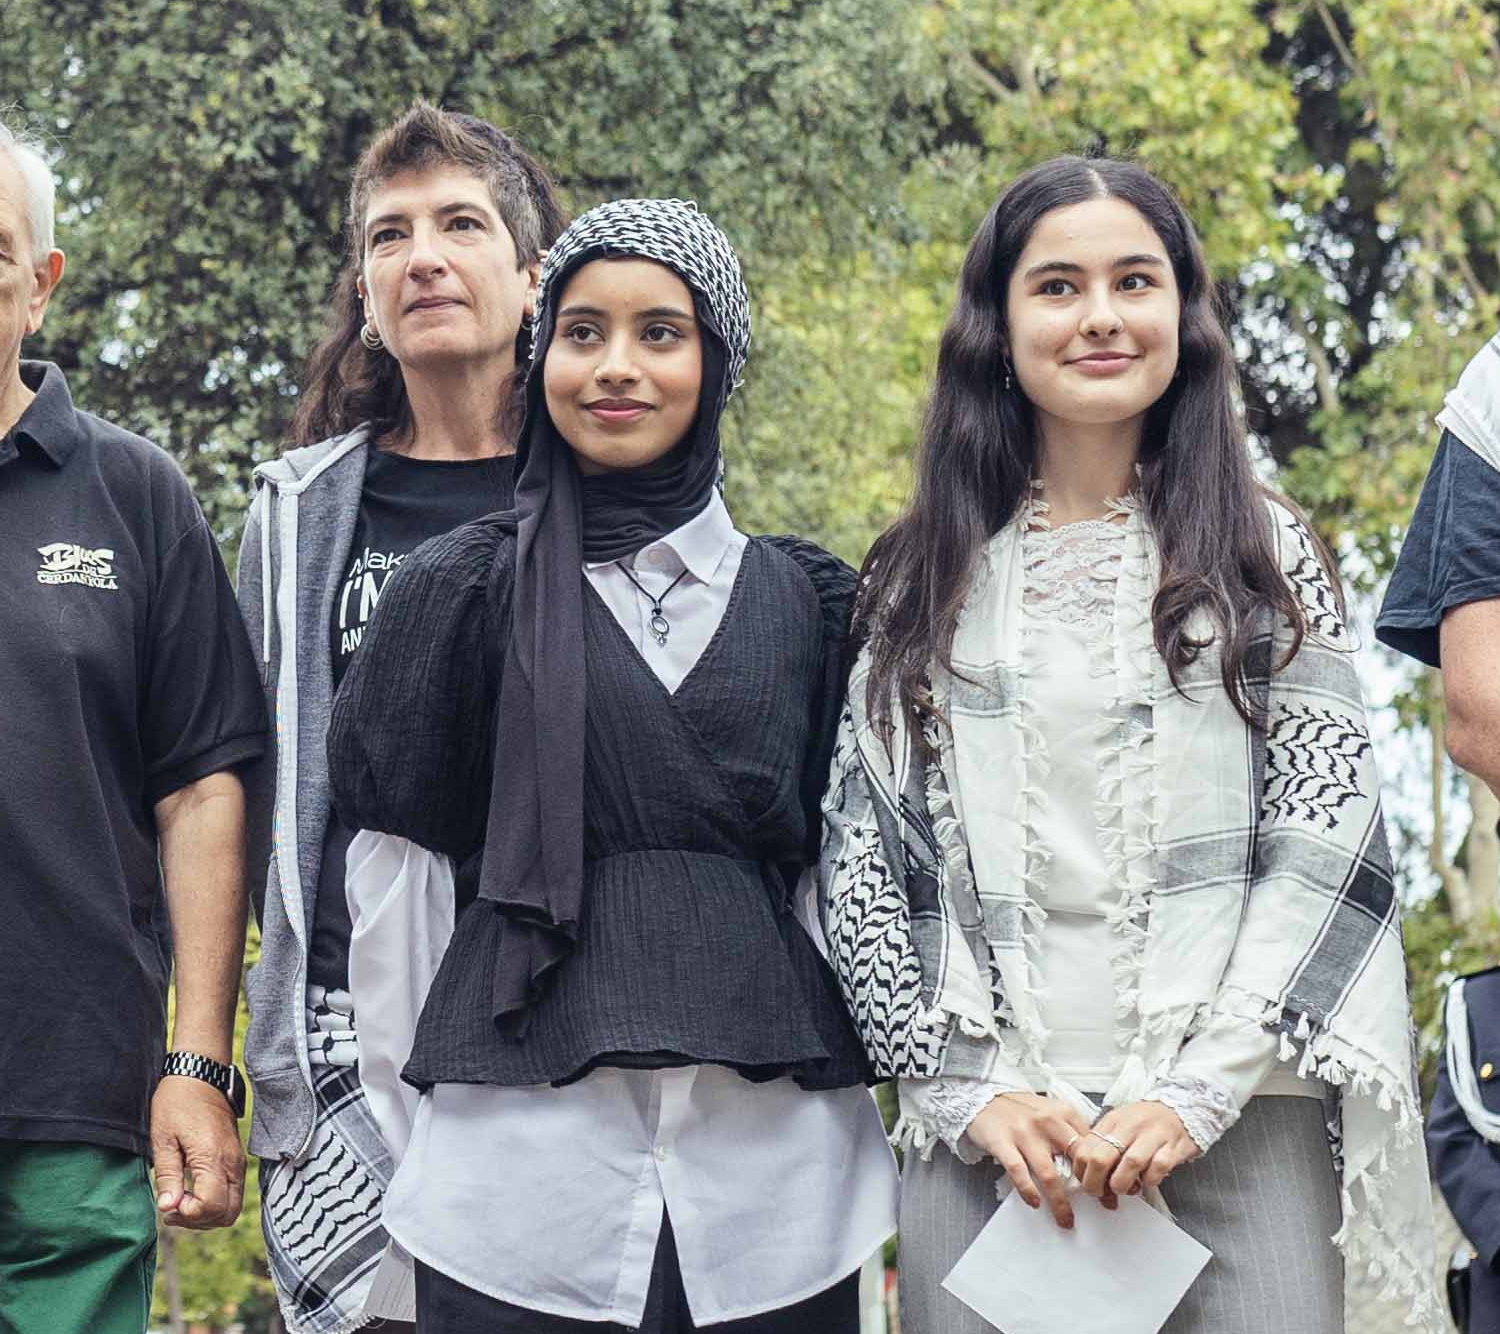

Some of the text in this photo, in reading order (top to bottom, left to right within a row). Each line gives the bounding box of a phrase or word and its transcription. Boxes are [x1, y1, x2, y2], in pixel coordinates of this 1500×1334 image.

[348, 547, 409, 578] Mak
[37, 572, 118, 589] CERDANYOLA
[341, 626, 366, 655] AN
